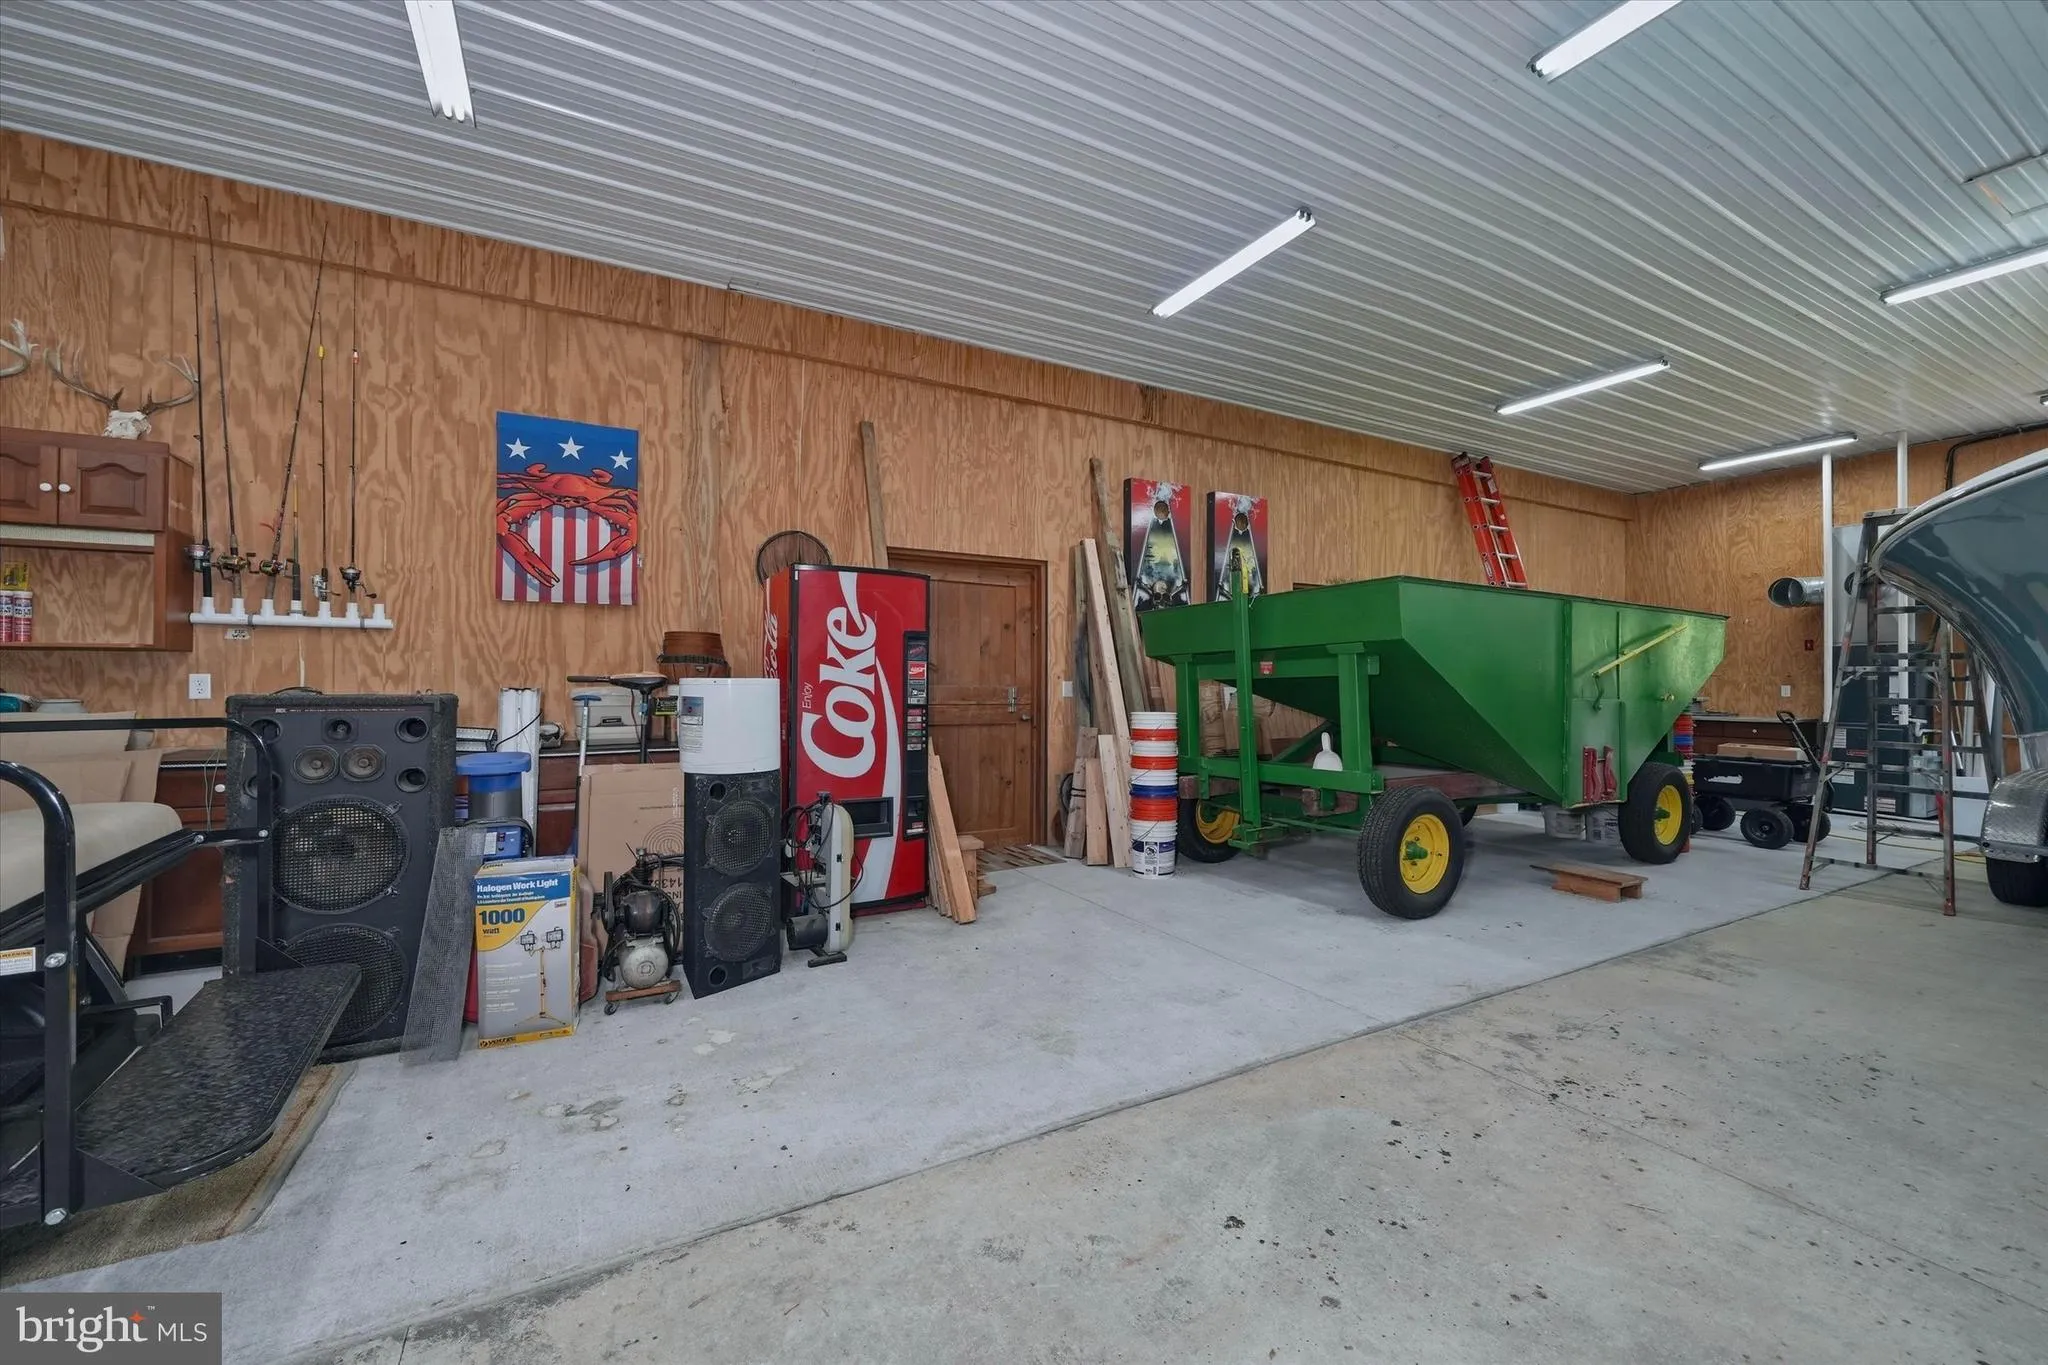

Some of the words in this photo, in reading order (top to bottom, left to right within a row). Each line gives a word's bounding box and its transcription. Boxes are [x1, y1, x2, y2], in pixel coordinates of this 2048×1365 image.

[800, 606, 877, 778] Coke
[802, 682, 814, 709] Enjoy
[477, 883, 512, 894] Halogen
[512, 881, 536, 891] Work
[536, 878, 559, 889] Light
[478, 907, 526, 926] 1000
